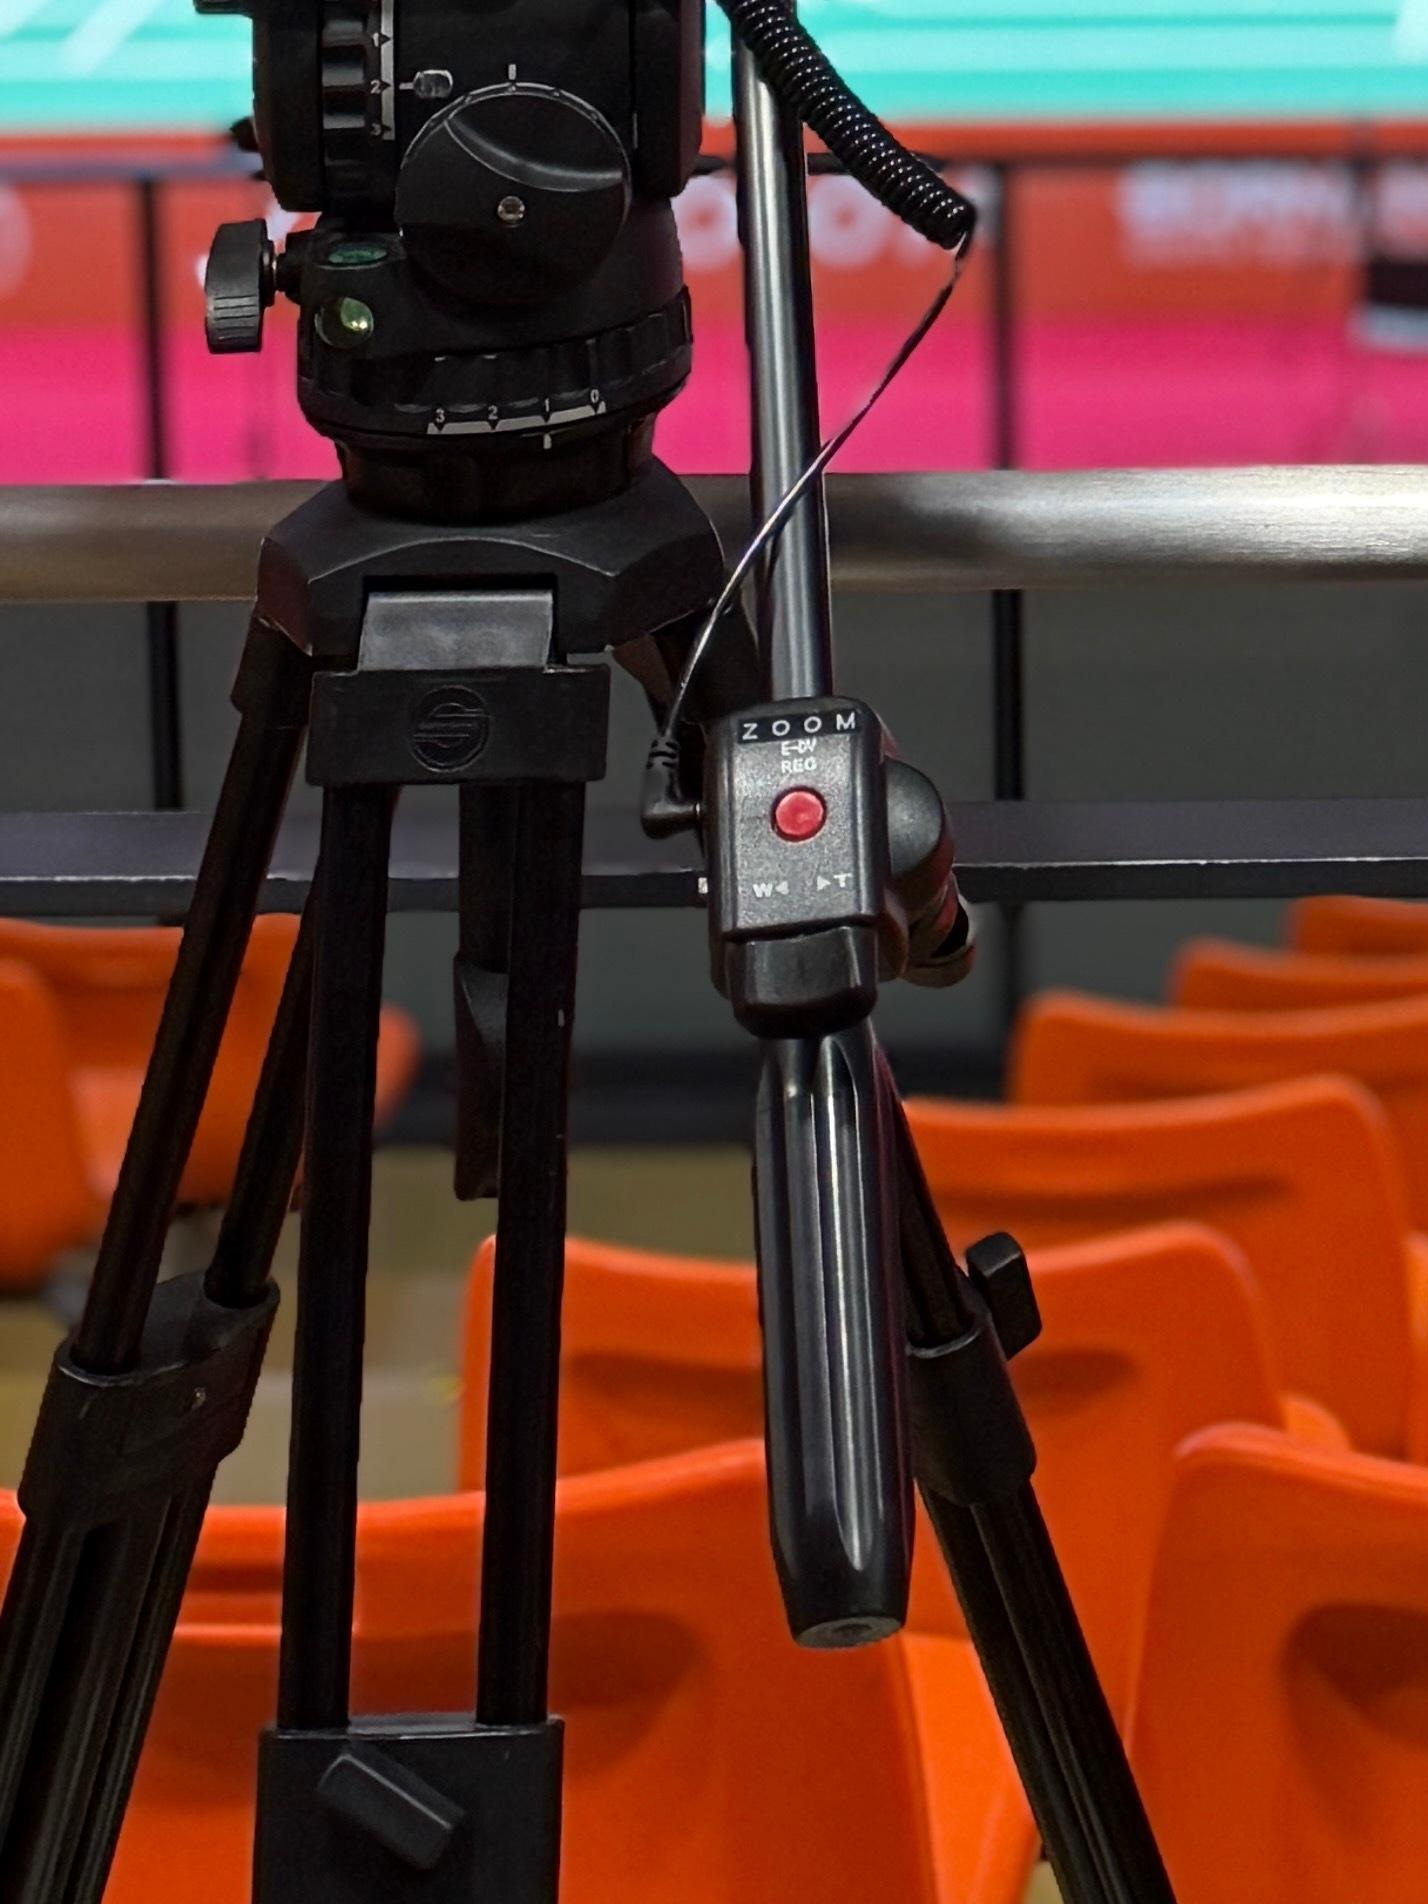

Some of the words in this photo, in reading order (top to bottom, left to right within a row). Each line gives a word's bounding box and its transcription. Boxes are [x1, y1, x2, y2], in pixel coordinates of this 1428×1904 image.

[371, 80, 381, 93] 2
[436, 408, 446, 423] 3
[488, 405, 498, 420] 2
[590, 389, 599, 404] 0
[742, 712, 856, 740] ZOOM
[833, 873, 853, 888] T
[753, 882, 773, 898] W
